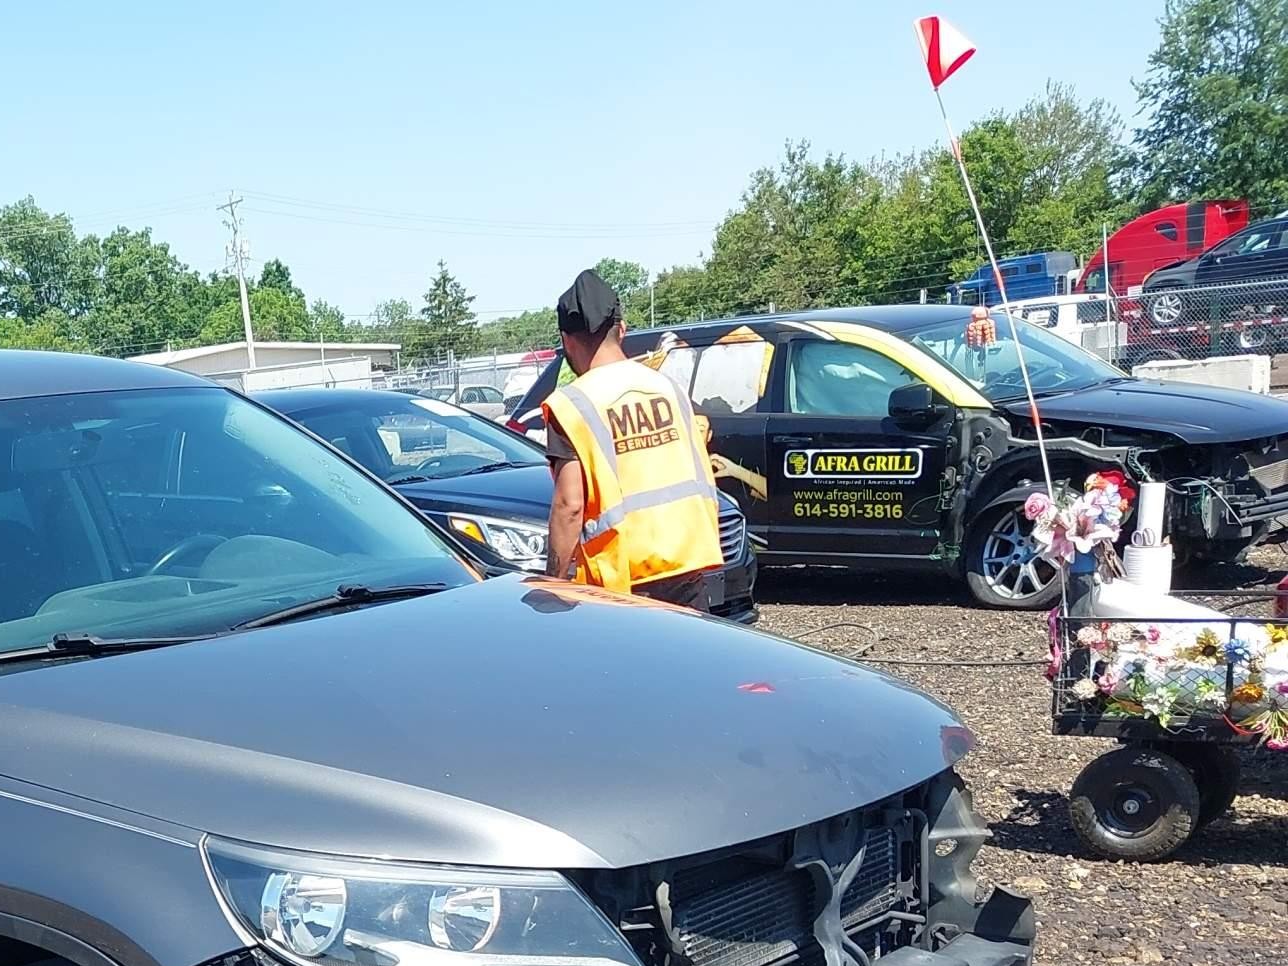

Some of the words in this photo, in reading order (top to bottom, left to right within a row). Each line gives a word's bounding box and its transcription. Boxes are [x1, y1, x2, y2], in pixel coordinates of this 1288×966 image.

[606, 397, 674, 440] MAD
[616, 430, 679, 453] SERVICES
[814, 456, 860, 472] AFRA
[863, 455, 915, 472] GRILL
[793, 489, 903, 502] www.afragrill.com
[793, 503, 903, 519] 614-591-3816
